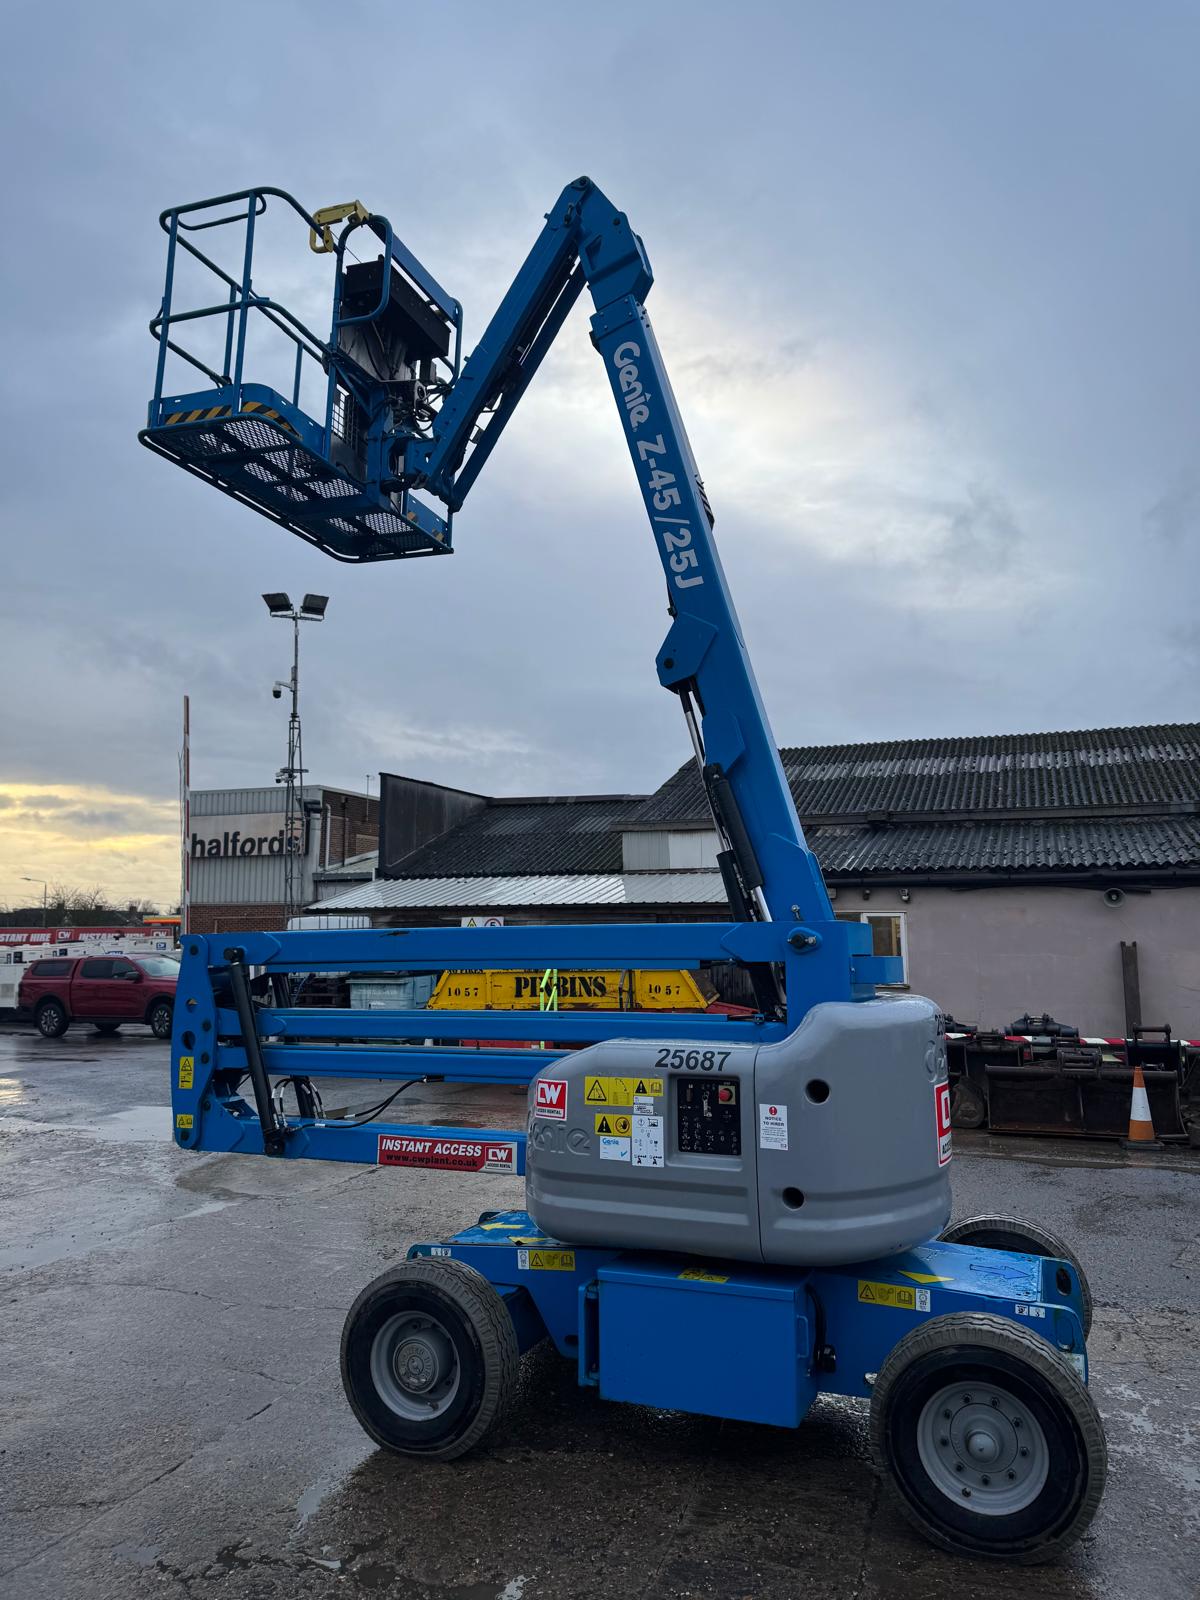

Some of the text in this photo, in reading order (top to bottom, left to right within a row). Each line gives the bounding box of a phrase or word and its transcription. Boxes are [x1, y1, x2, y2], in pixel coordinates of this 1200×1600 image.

[613, 341, 704, 589] Genie Z-45/25J
[191, 829, 301, 857] halfords
[30, 933, 51, 942] HIRE
[447, 987, 479, 997] 1057
[648, 984, 681, 996] 1057
[654, 1048, 732, 1072] 25687
[537, 1083, 562, 1105] CW
[381, 1138, 482, 1157] INSTANT ACCESS
[488, 1148, 509, 1161] CW
[386, 1153, 478, 1168] www.cwplant.co.uk
